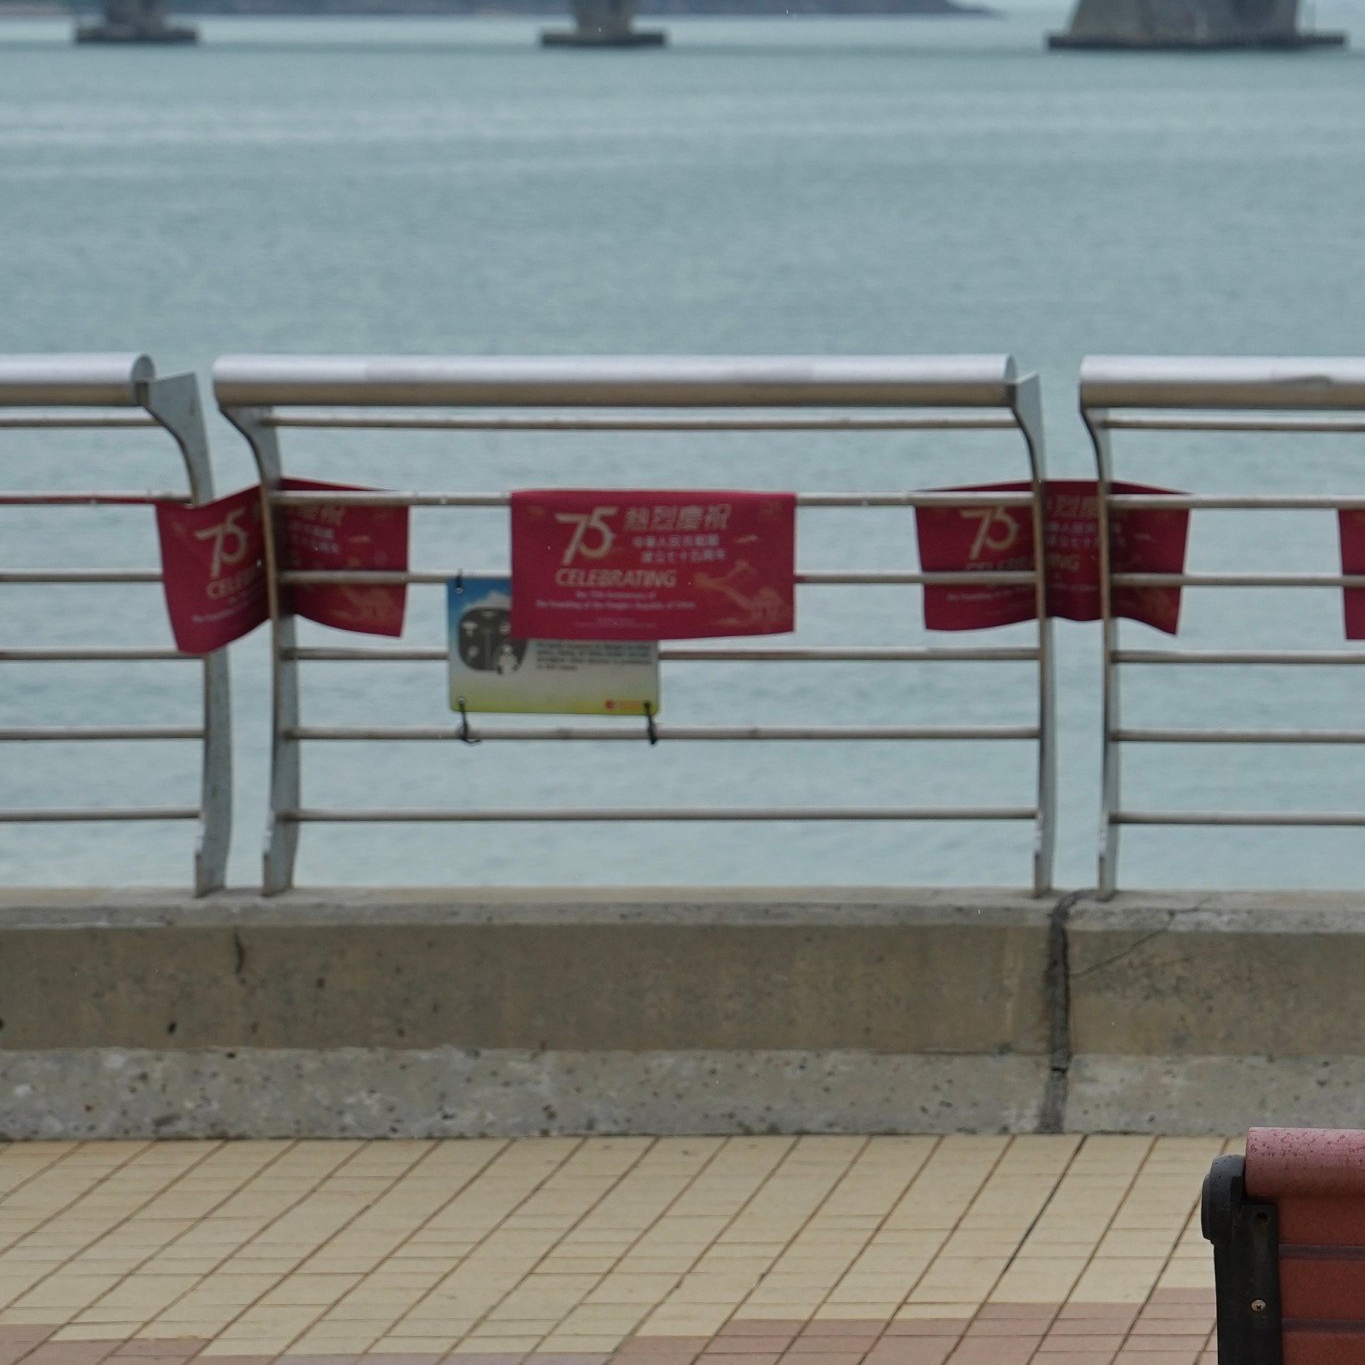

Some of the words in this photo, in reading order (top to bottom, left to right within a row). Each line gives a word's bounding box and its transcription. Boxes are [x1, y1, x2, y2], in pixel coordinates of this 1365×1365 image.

[554, 506, 617, 567] 75
[623, 504, 732, 531] 熱烈慶祝
[194, 507, 248, 580] 75
[555, 569, 678, 588] CELEBRATING
